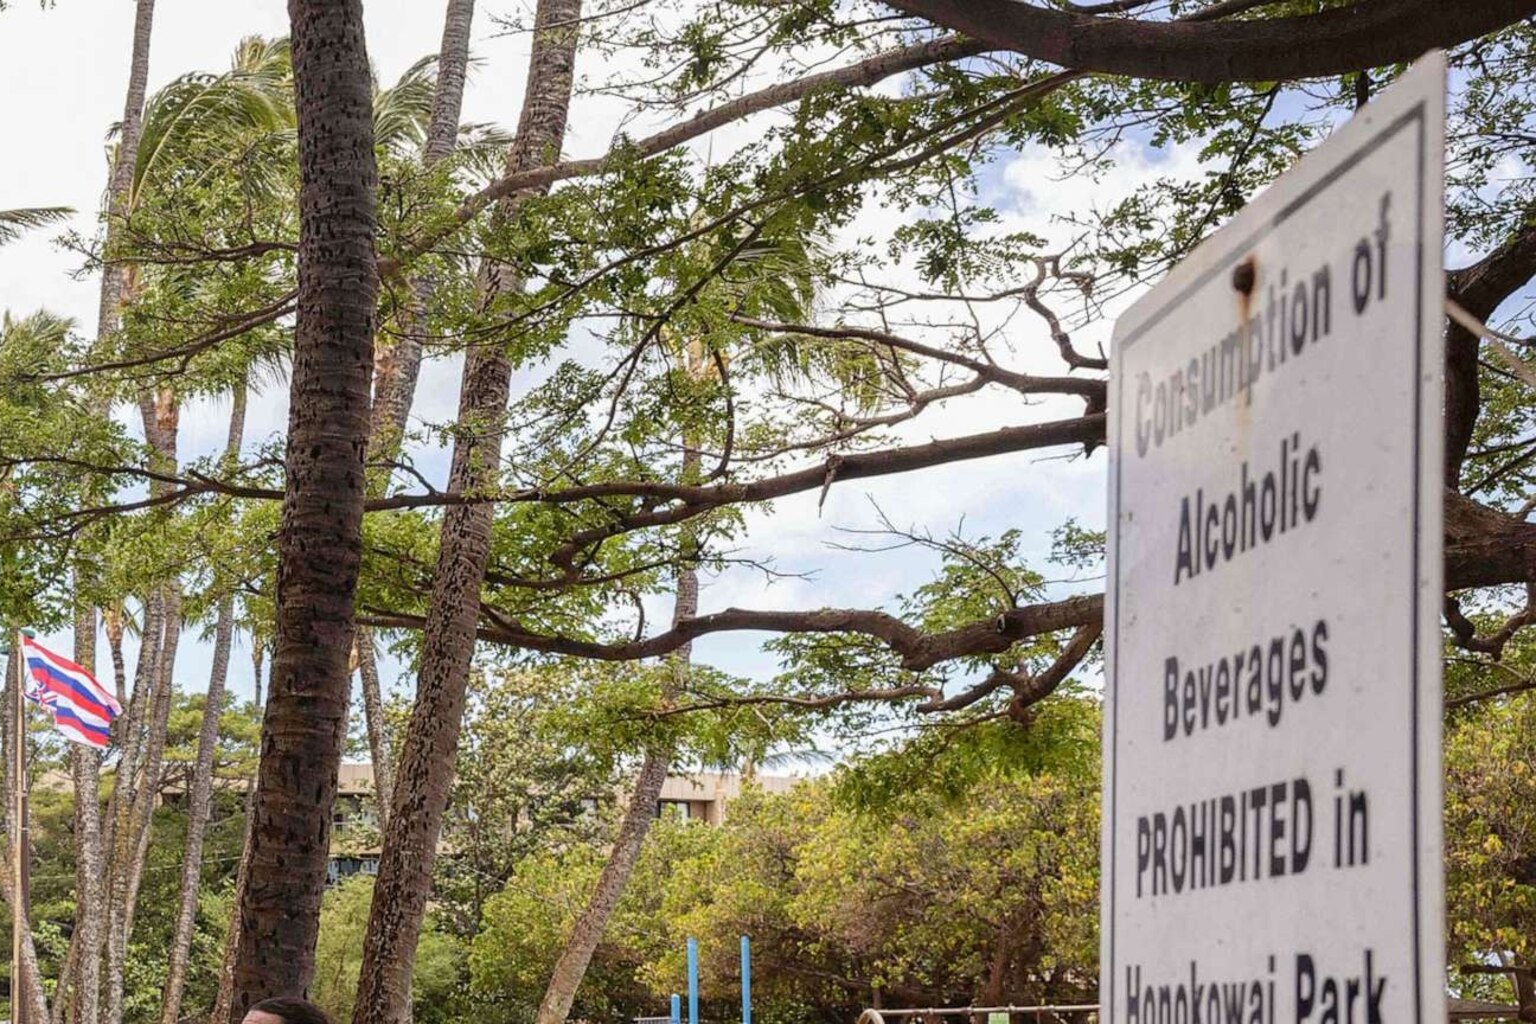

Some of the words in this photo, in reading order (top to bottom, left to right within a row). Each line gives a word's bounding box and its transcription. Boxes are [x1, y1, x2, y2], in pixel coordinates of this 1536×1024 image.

[1136, 263, 1332, 458] Consumption
[1353, 190, 1391, 317] of
[1174, 432, 1322, 586] Alcoholic
[1164, 619, 1330, 743] Beverages
[1137, 778, 1314, 899] PROHIBITED
[1333, 768, 1369, 869] in
